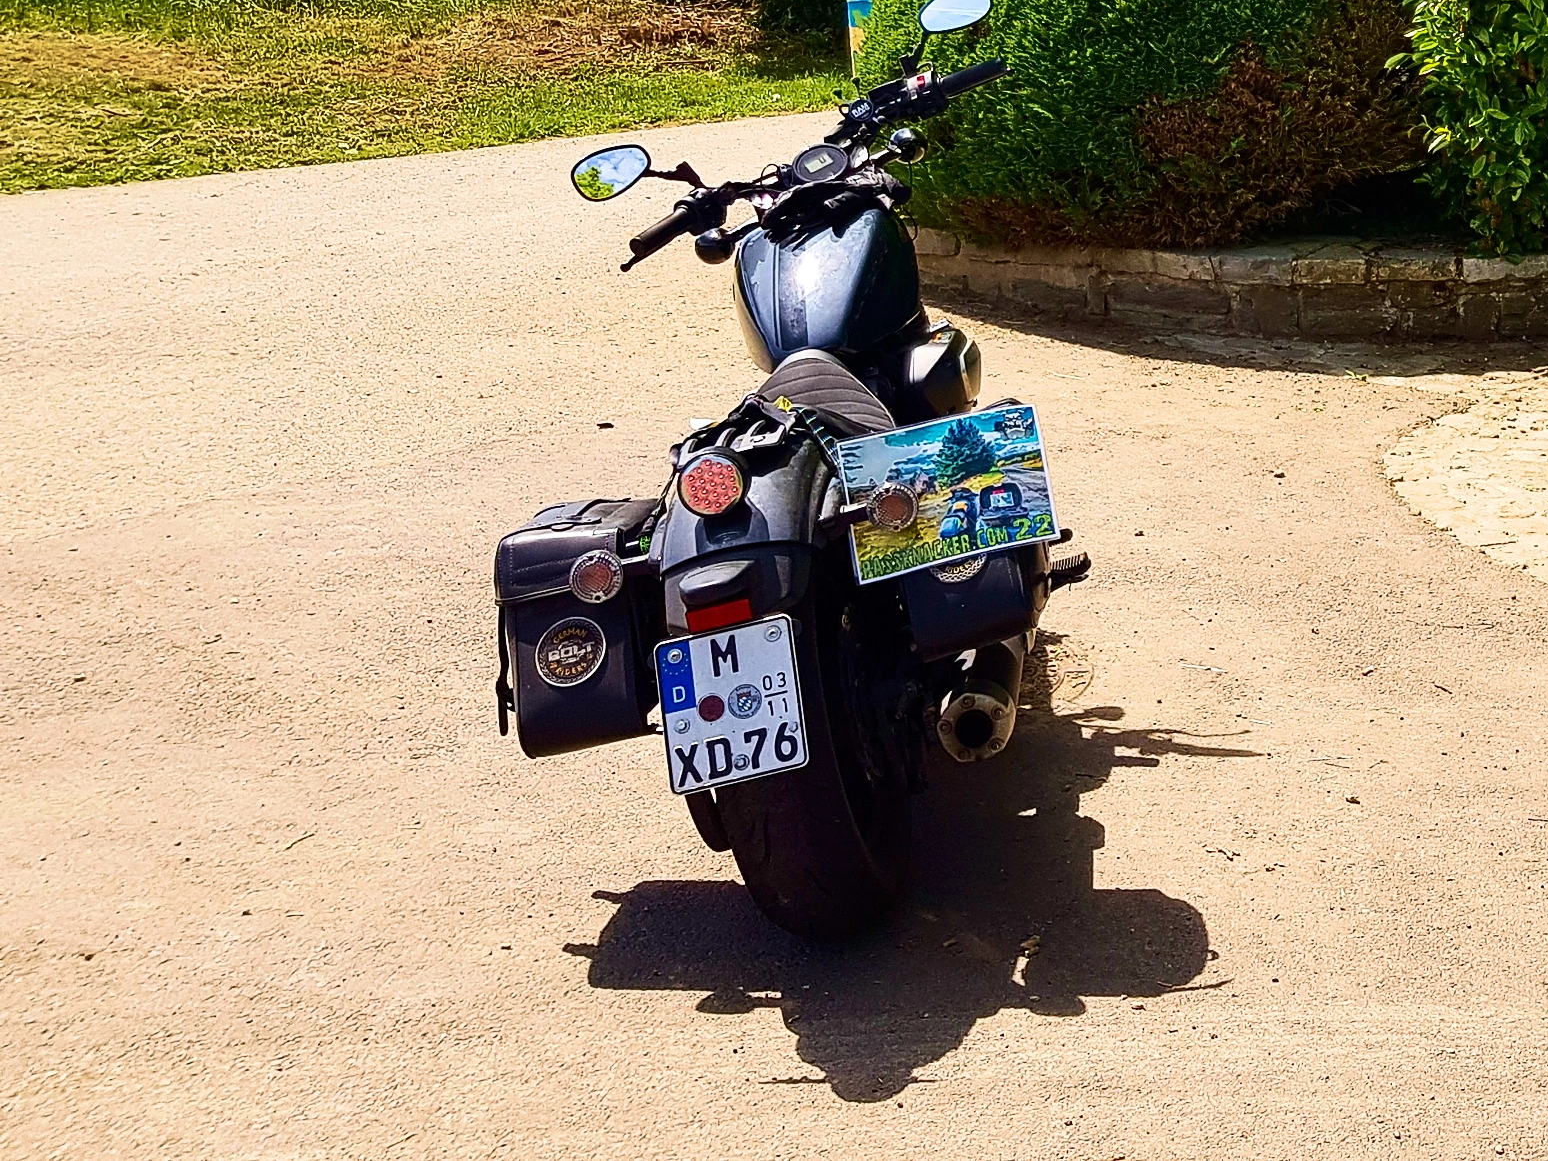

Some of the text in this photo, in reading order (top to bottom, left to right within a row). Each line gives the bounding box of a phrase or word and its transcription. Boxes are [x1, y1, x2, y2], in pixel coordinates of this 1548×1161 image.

[861, 514, 1054, 581] PASSKNACKER.COM 22
[553, 627, 588, 644] GERMAN
[548, 641, 595, 662] BOLT
[709, 634, 739, 677] M
[762, 672, 787, 691] 03
[672, 686, 686, 703] D
[767, 698, 789, 716] 11
[674, 722, 799, 787] XD 76
